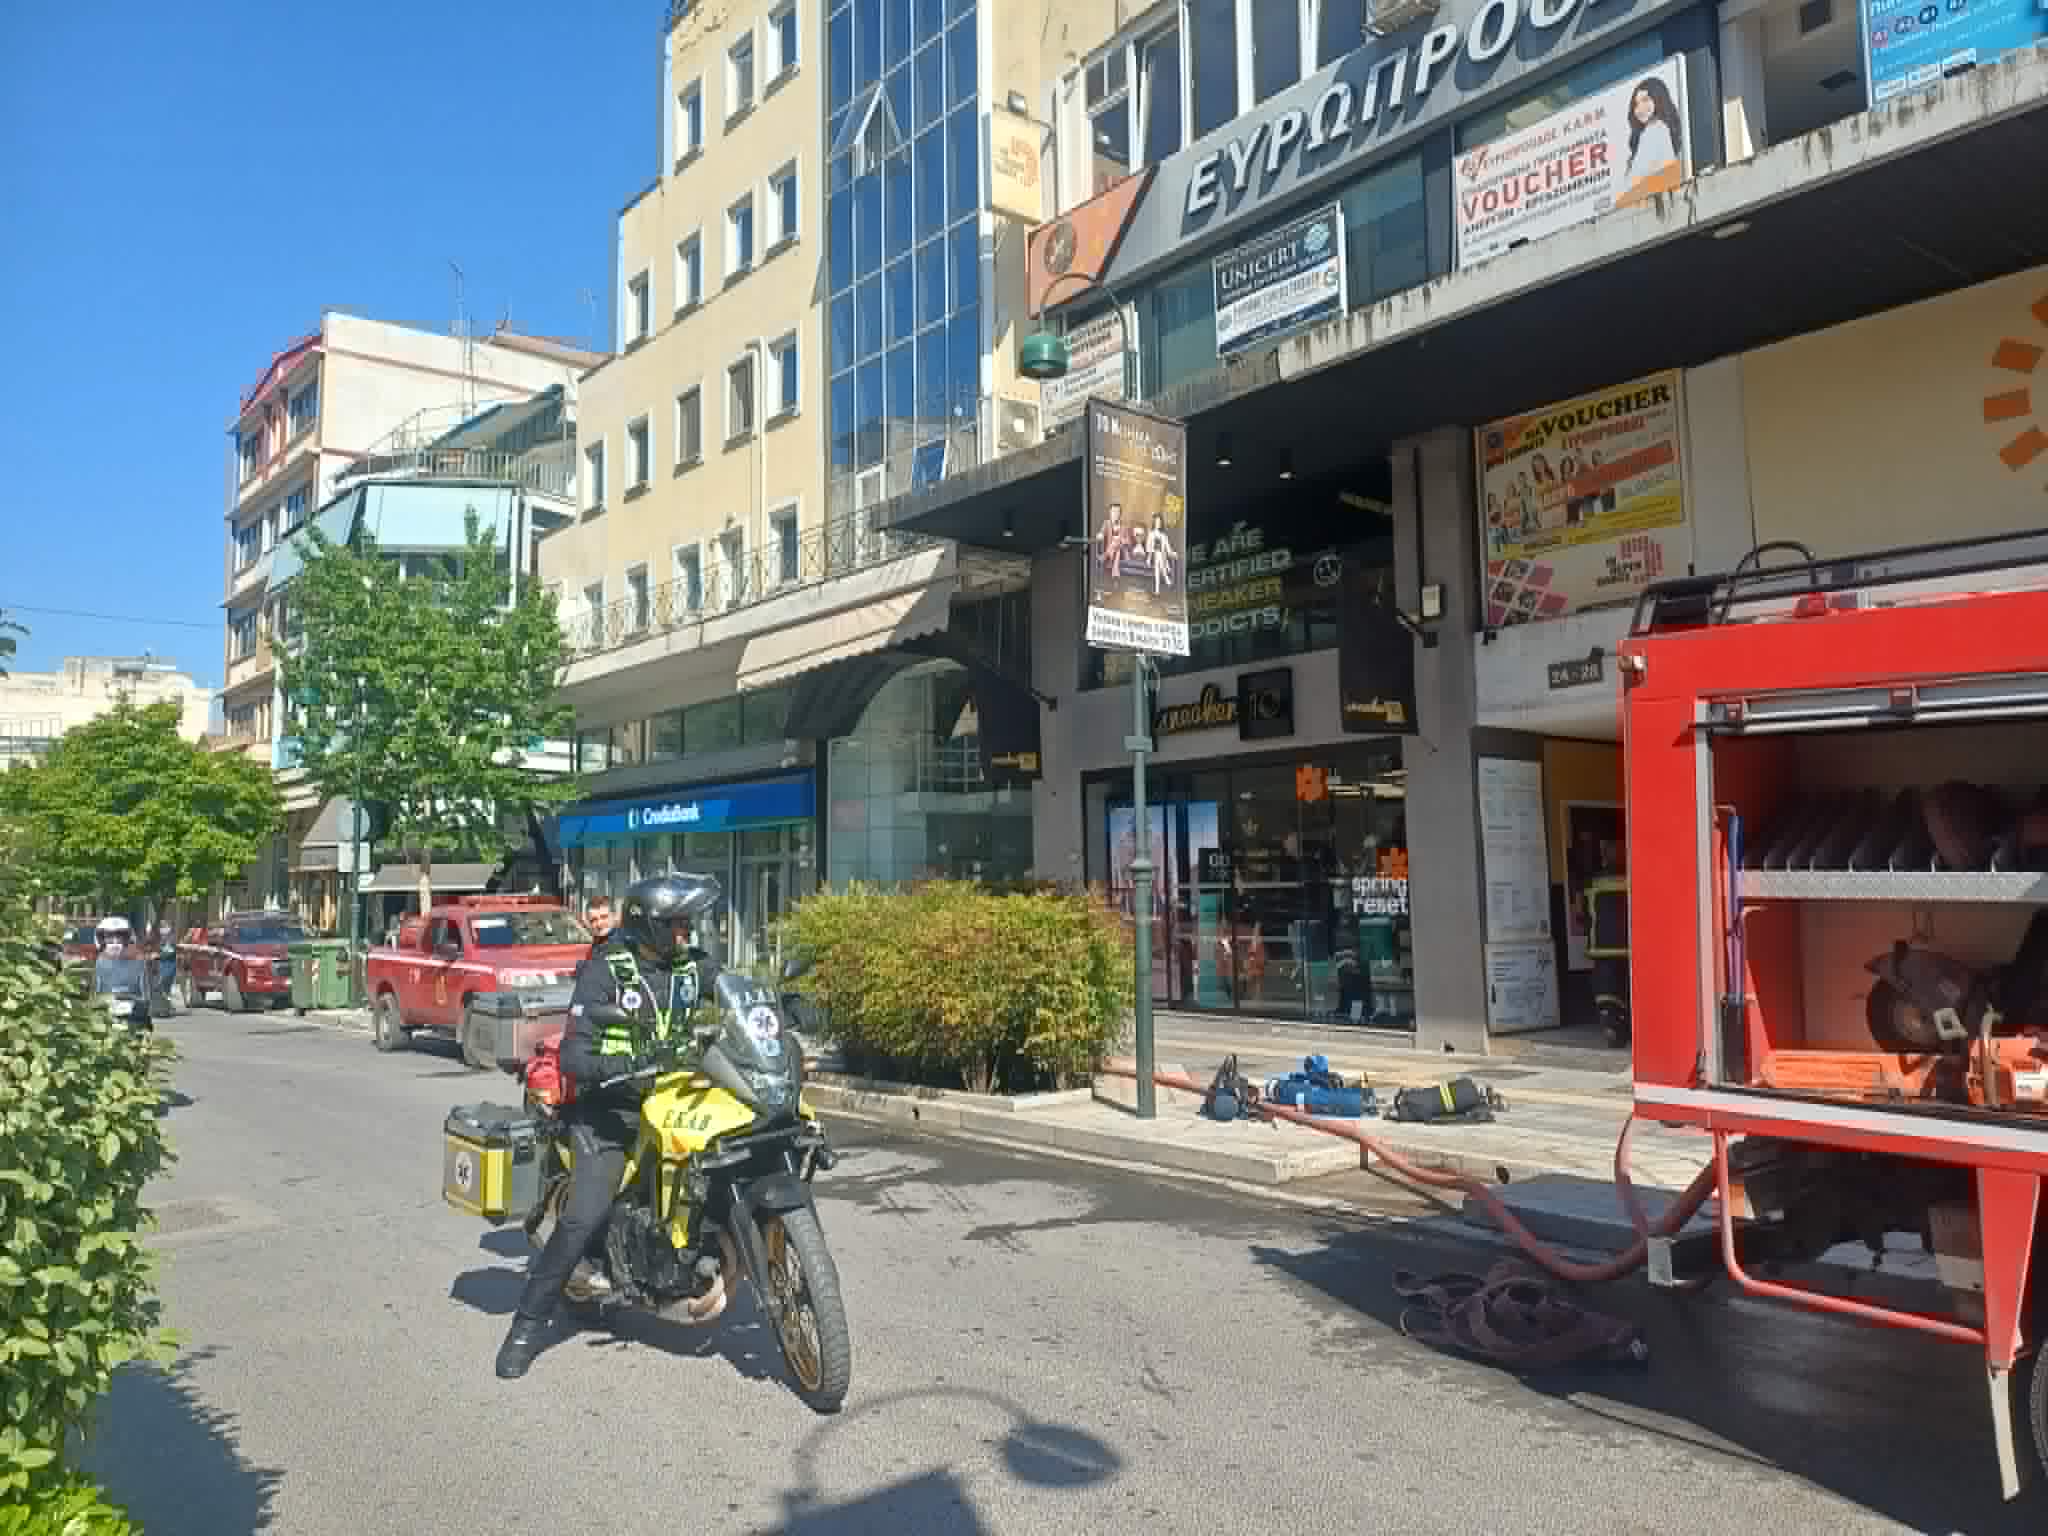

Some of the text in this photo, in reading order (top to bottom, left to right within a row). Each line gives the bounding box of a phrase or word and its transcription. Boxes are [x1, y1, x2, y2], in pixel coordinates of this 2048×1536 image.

[1462, 143, 1609, 222] VOUCHER
[1221, 242, 1297, 290] UNICERT
[1541, 384, 1671, 434] VOUCHER
[1214, 527, 1265, 558] ARE
[1186, 549, 1294, 588] ERTIFIED
[1186, 578, 1281, 612] NEAKER
[1351, 876, 1409, 897] spring
